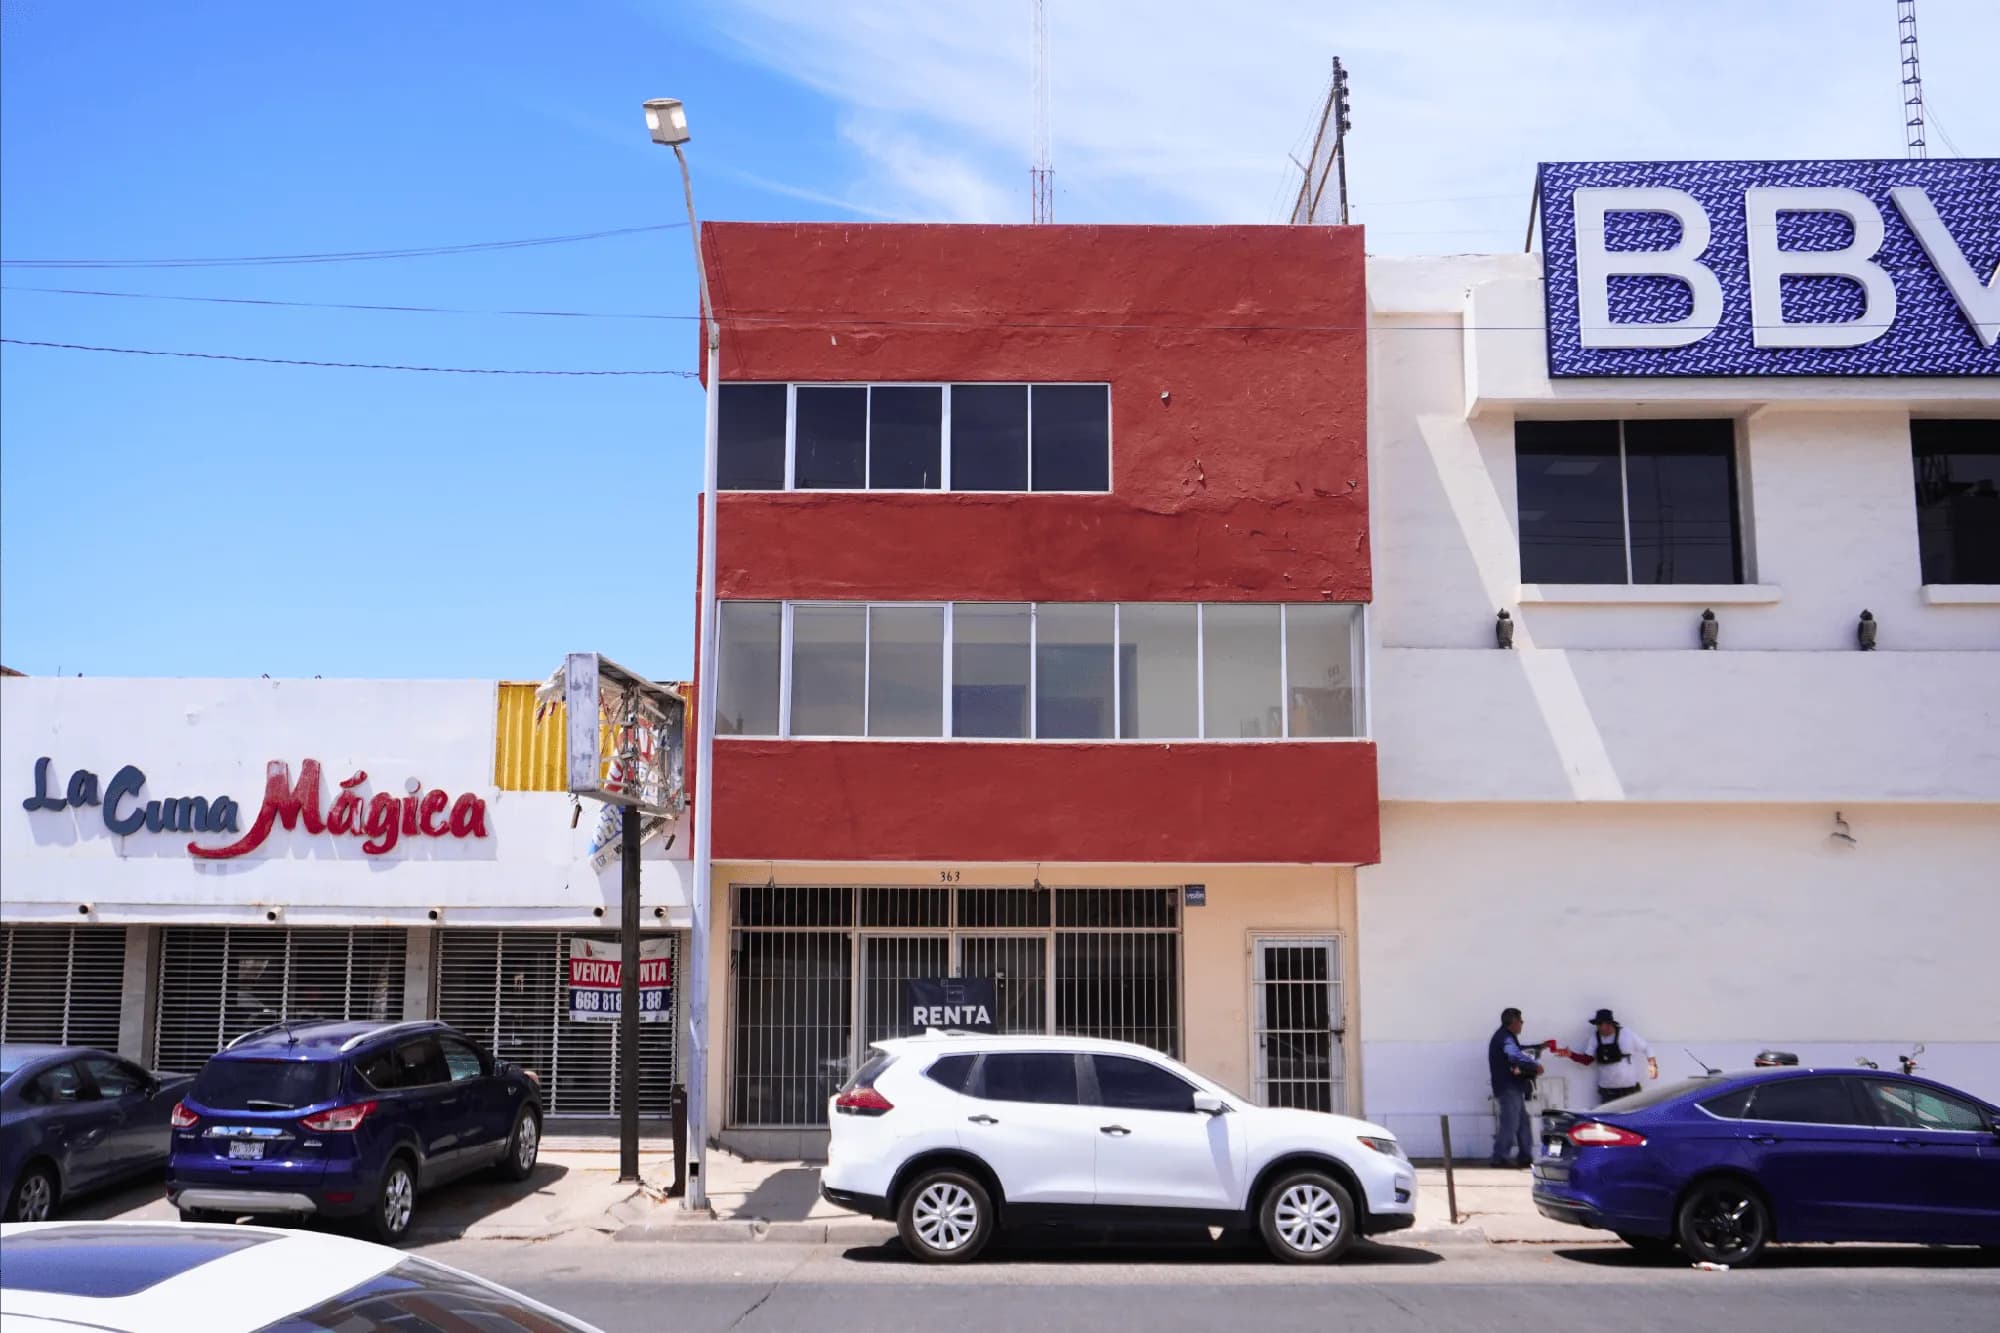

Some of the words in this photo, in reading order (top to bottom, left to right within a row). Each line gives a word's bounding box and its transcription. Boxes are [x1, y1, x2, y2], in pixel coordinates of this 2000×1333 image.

[22, 756, 102, 812] La
[102, 764, 240, 835] Cuna
[187, 757, 489, 859] Mágica
[940, 871, 960, 882] 363
[573, 961, 667, 986] VENTA/NTA
[575, 991, 600, 1010] 668
[913, 1005, 992, 1025] RENTA
